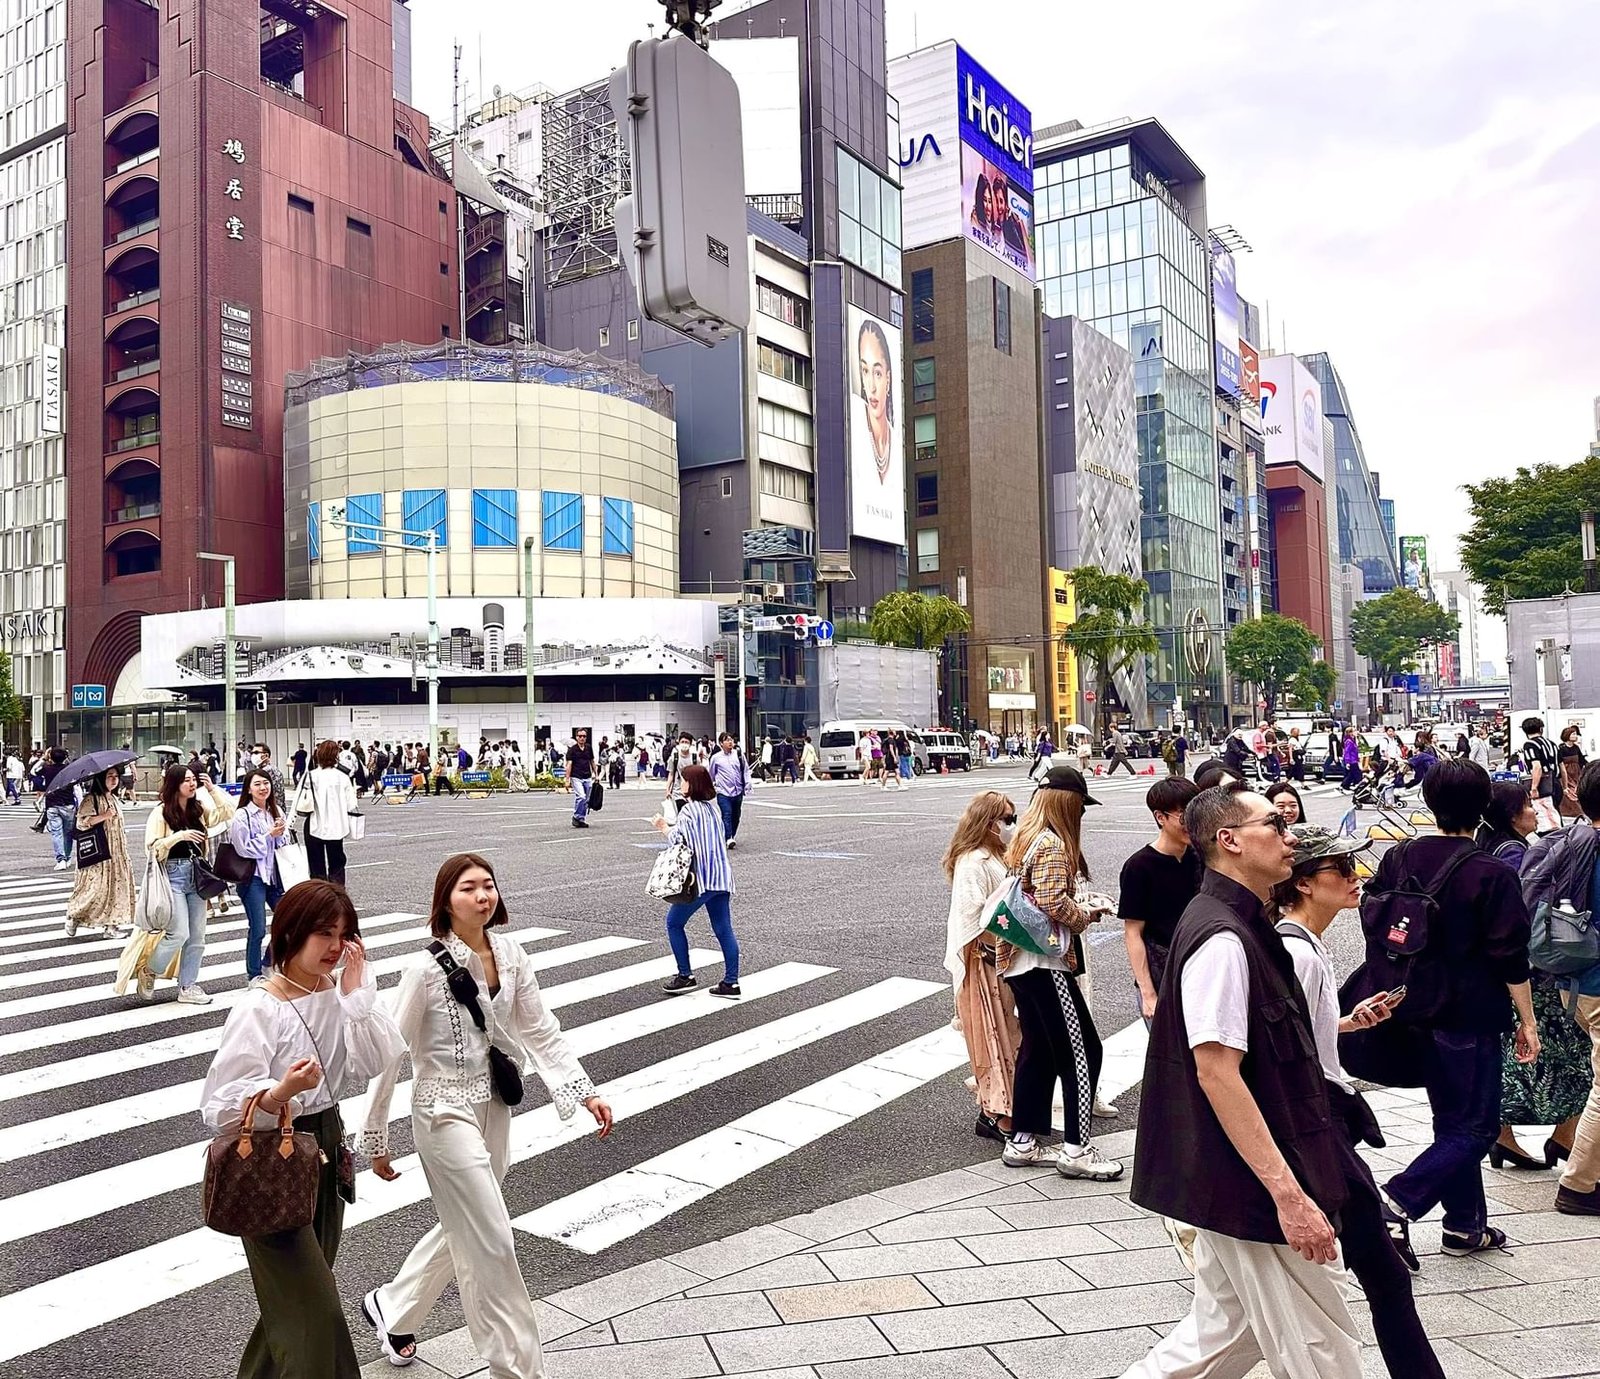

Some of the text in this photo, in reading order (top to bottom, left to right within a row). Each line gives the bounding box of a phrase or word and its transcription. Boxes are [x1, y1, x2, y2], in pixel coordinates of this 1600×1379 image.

[965, 72, 1033, 169] Haier
[221, 138, 245, 241] 鳩居堂
[46, 355, 58, 422] TASAKI
[866, 504, 893, 520] TASAKI
